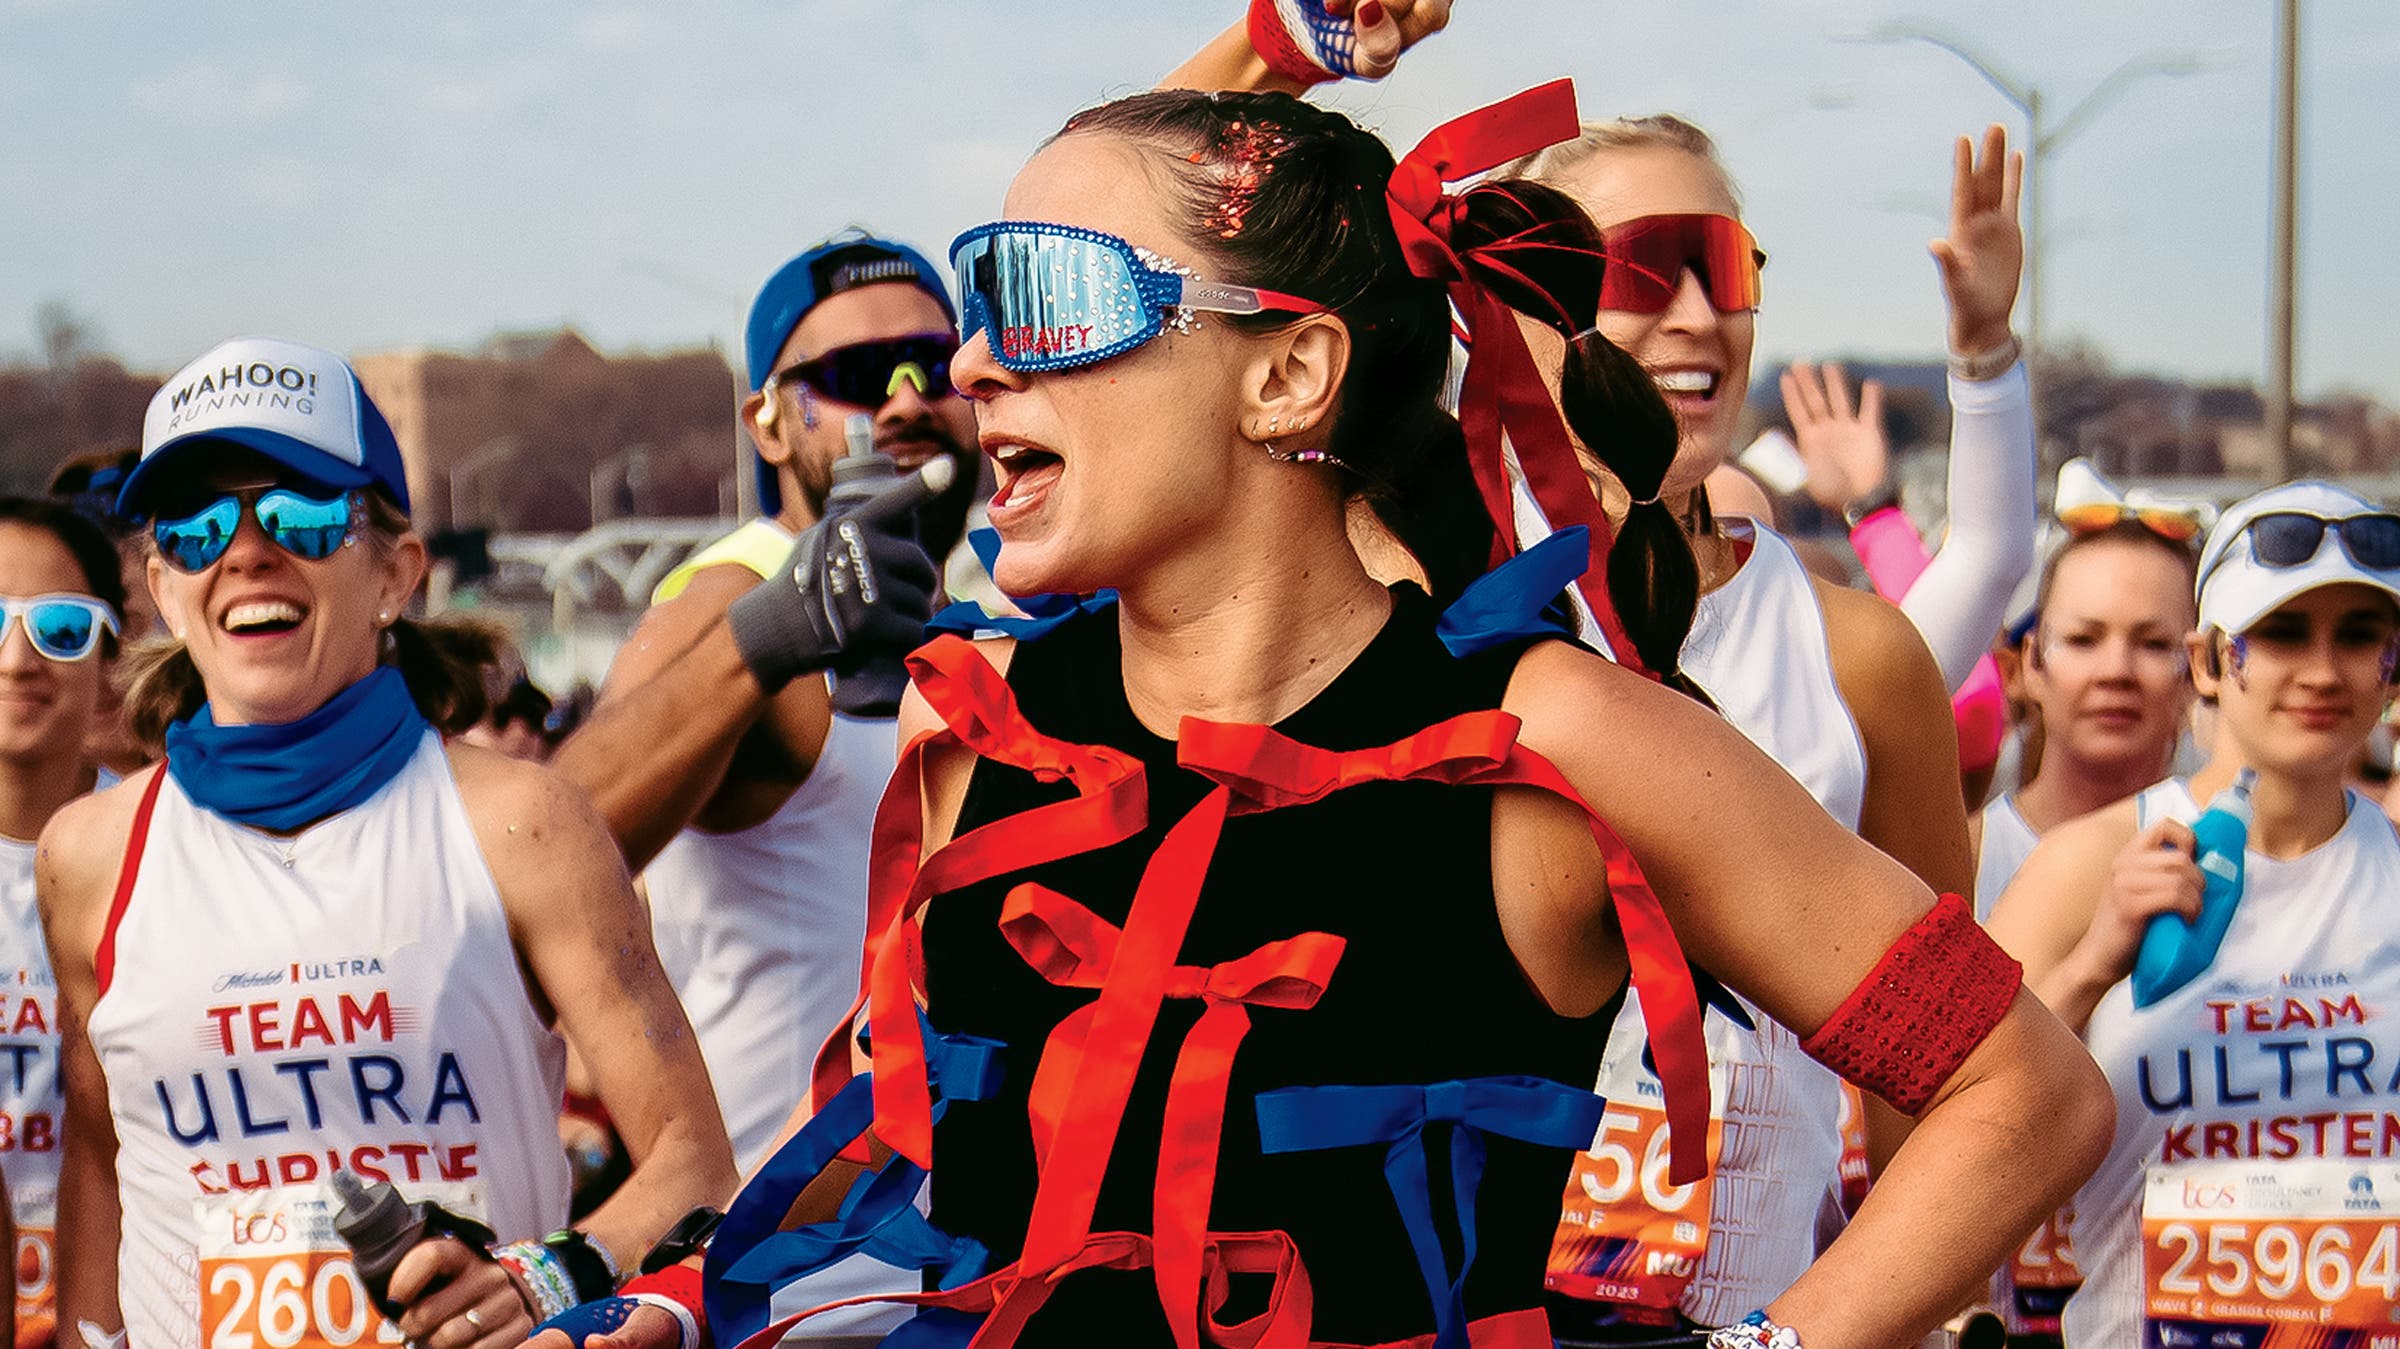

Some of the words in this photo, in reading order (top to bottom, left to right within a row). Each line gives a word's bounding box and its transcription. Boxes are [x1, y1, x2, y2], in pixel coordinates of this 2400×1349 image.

[1002, 323, 1093, 358] BRAVEY
[171, 361, 317, 412] WAHOO!
[168, 391, 314, 433] RUNNING
[304, 957, 385, 980] ULTRA
[206, 988, 394, 1057] TEAM
[2206, 993, 2367, 1035] TEAM
[154, 1052, 481, 1147] ULTRA
[2183, 1177, 2236, 1210] tcs
[231, 1206, 287, 1244] tcs
[2157, 1222, 2400, 1301] 25964
[1595, 1283, 1641, 1300] 2023
